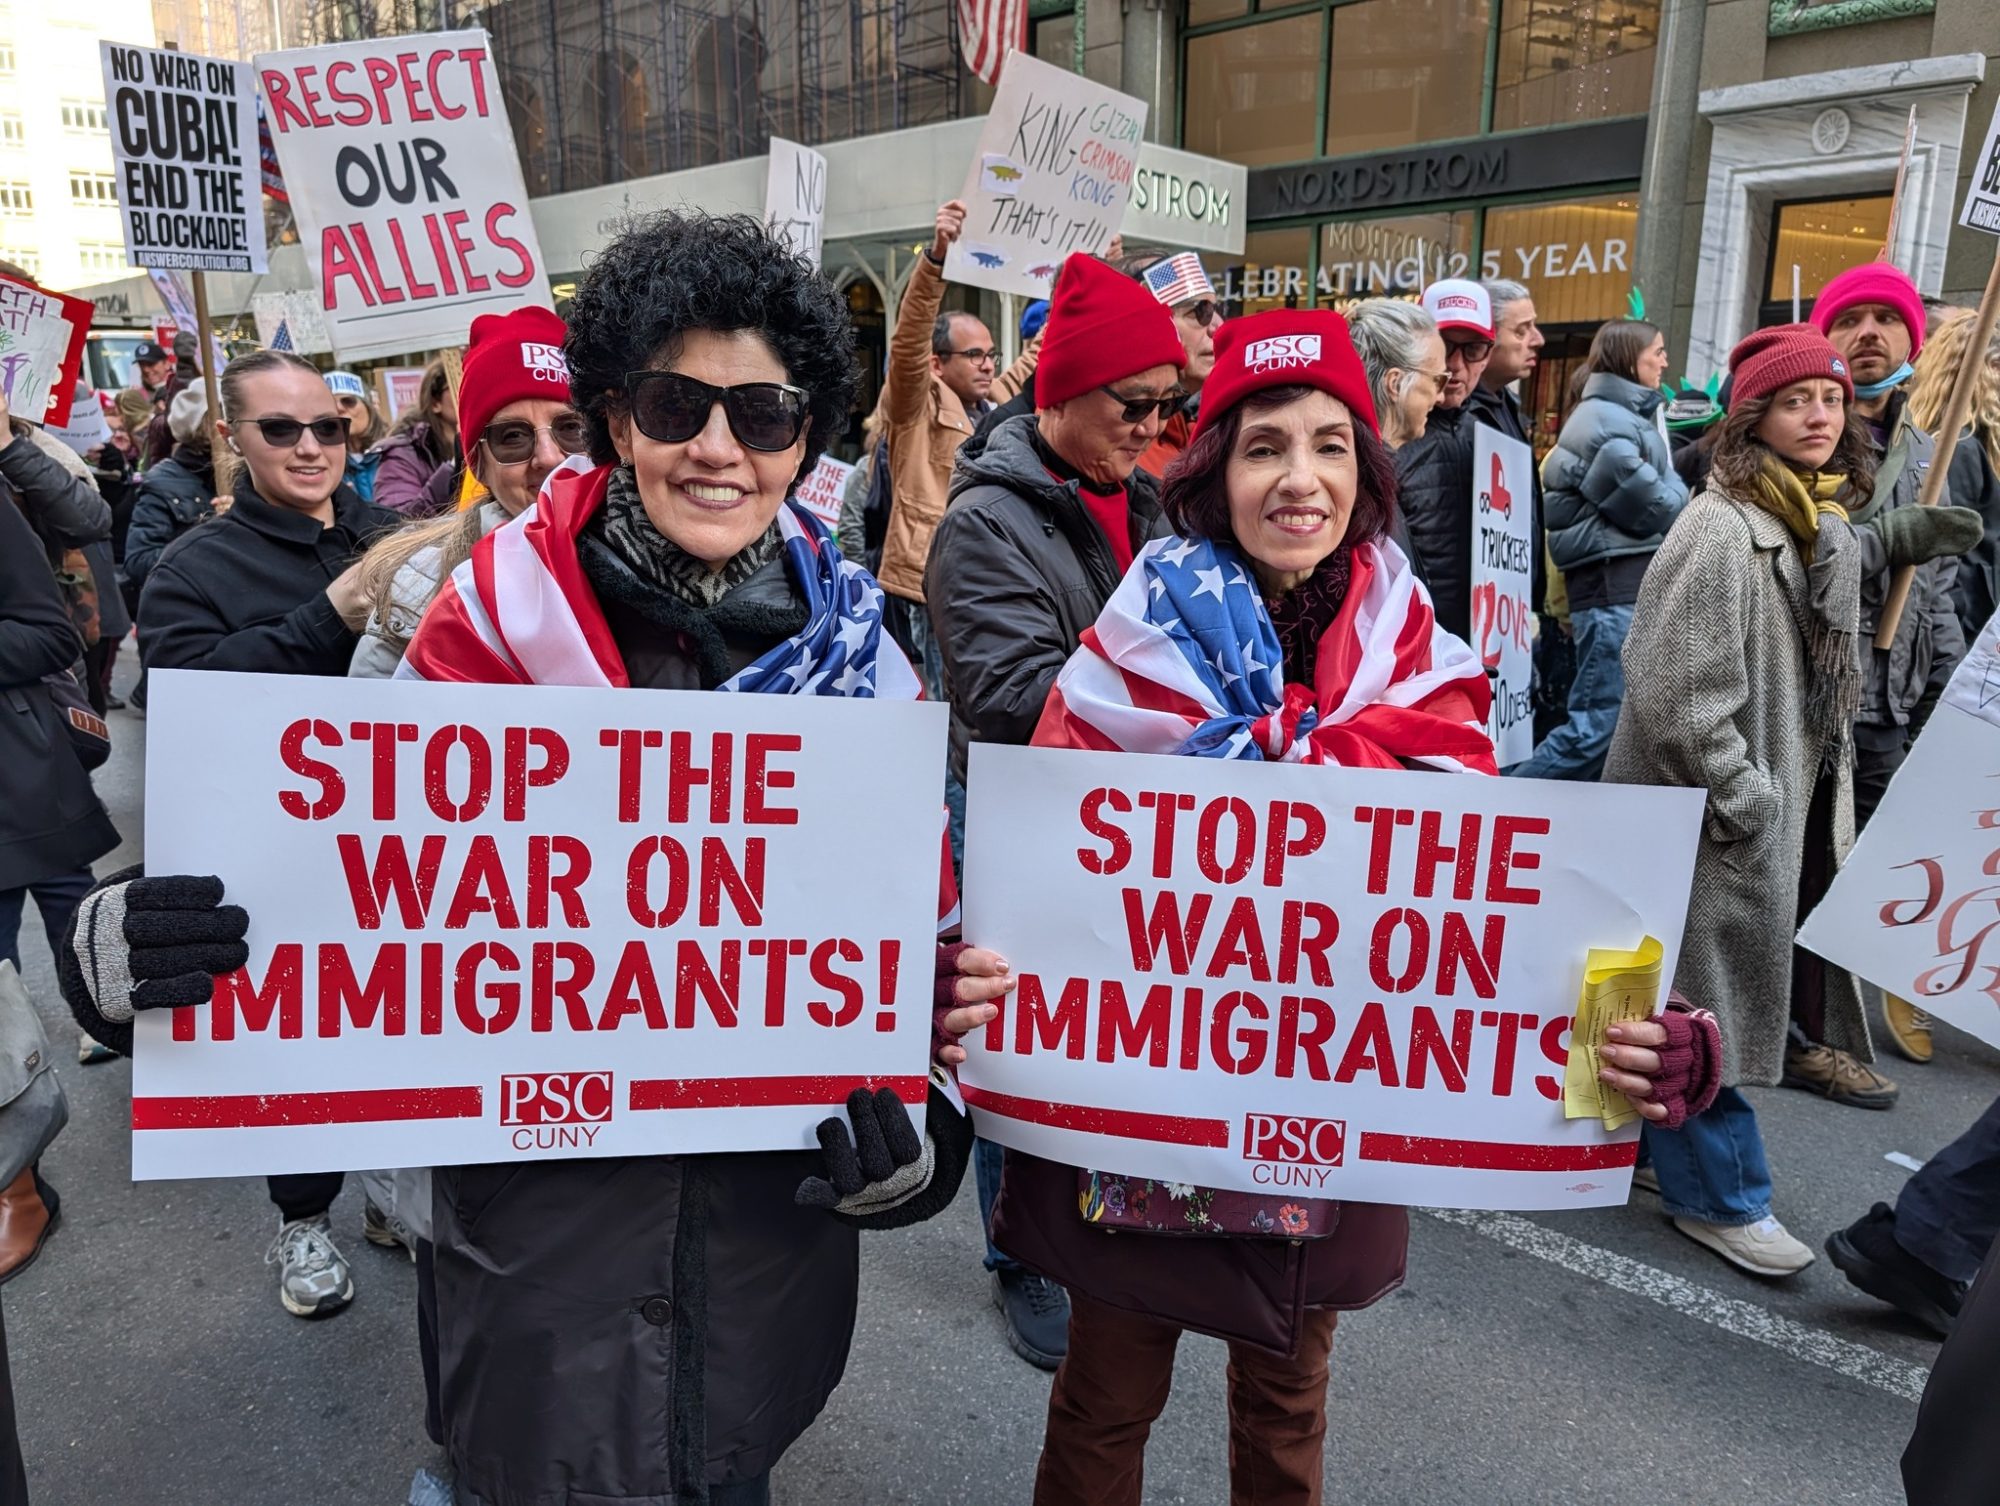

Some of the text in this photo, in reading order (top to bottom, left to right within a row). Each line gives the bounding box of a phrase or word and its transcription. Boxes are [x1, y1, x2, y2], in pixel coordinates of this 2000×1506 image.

[111, 47, 236, 96] NO WAR ON
[261, 48, 489, 133] RESPECT
[116, 87, 242, 166] CUBA!
[1008, 92, 1087, 176] KING
[124, 161, 246, 214] END THE
[336, 138, 459, 207] OUR
[1079, 140, 1134, 186] CRIMSON
[1274, 148, 1511, 210] NORDSTROM
[1069, 170, 1115, 207] KONG
[1130, 168, 1230, 227] STROM
[130, 211, 249, 251] BLOCKADE!
[989, 196, 1059, 245] THAT'S
[139, 253, 249, 271] ANSWERCOALITION.ORG
[322, 203, 535, 310] ALLIES
[1515, 238, 1628, 280] YEAR
[525, 344, 568, 369] PS
[1248, 336, 1319, 363] PSC
[1253, 356, 1314, 375] CUNY
[532, 367, 572, 385] CUN
[816, 477, 836, 494] ON
[819, 461, 846, 482] THE
[1480, 526, 1529, 575] TRUCKERS
[278, 718, 801, 825] STOP THE
[1077, 787, 1551, 905] STOP THE
[336, 834, 766, 931] WAR ON
[1121, 887, 1506, 998] WAR ON
[503, 1073, 611, 1124] PSC
[512, 1126, 601, 1150] CUNY
[1245, 1115, 1343, 1164] PSC
[1252, 1163, 1332, 1188] CUNY
